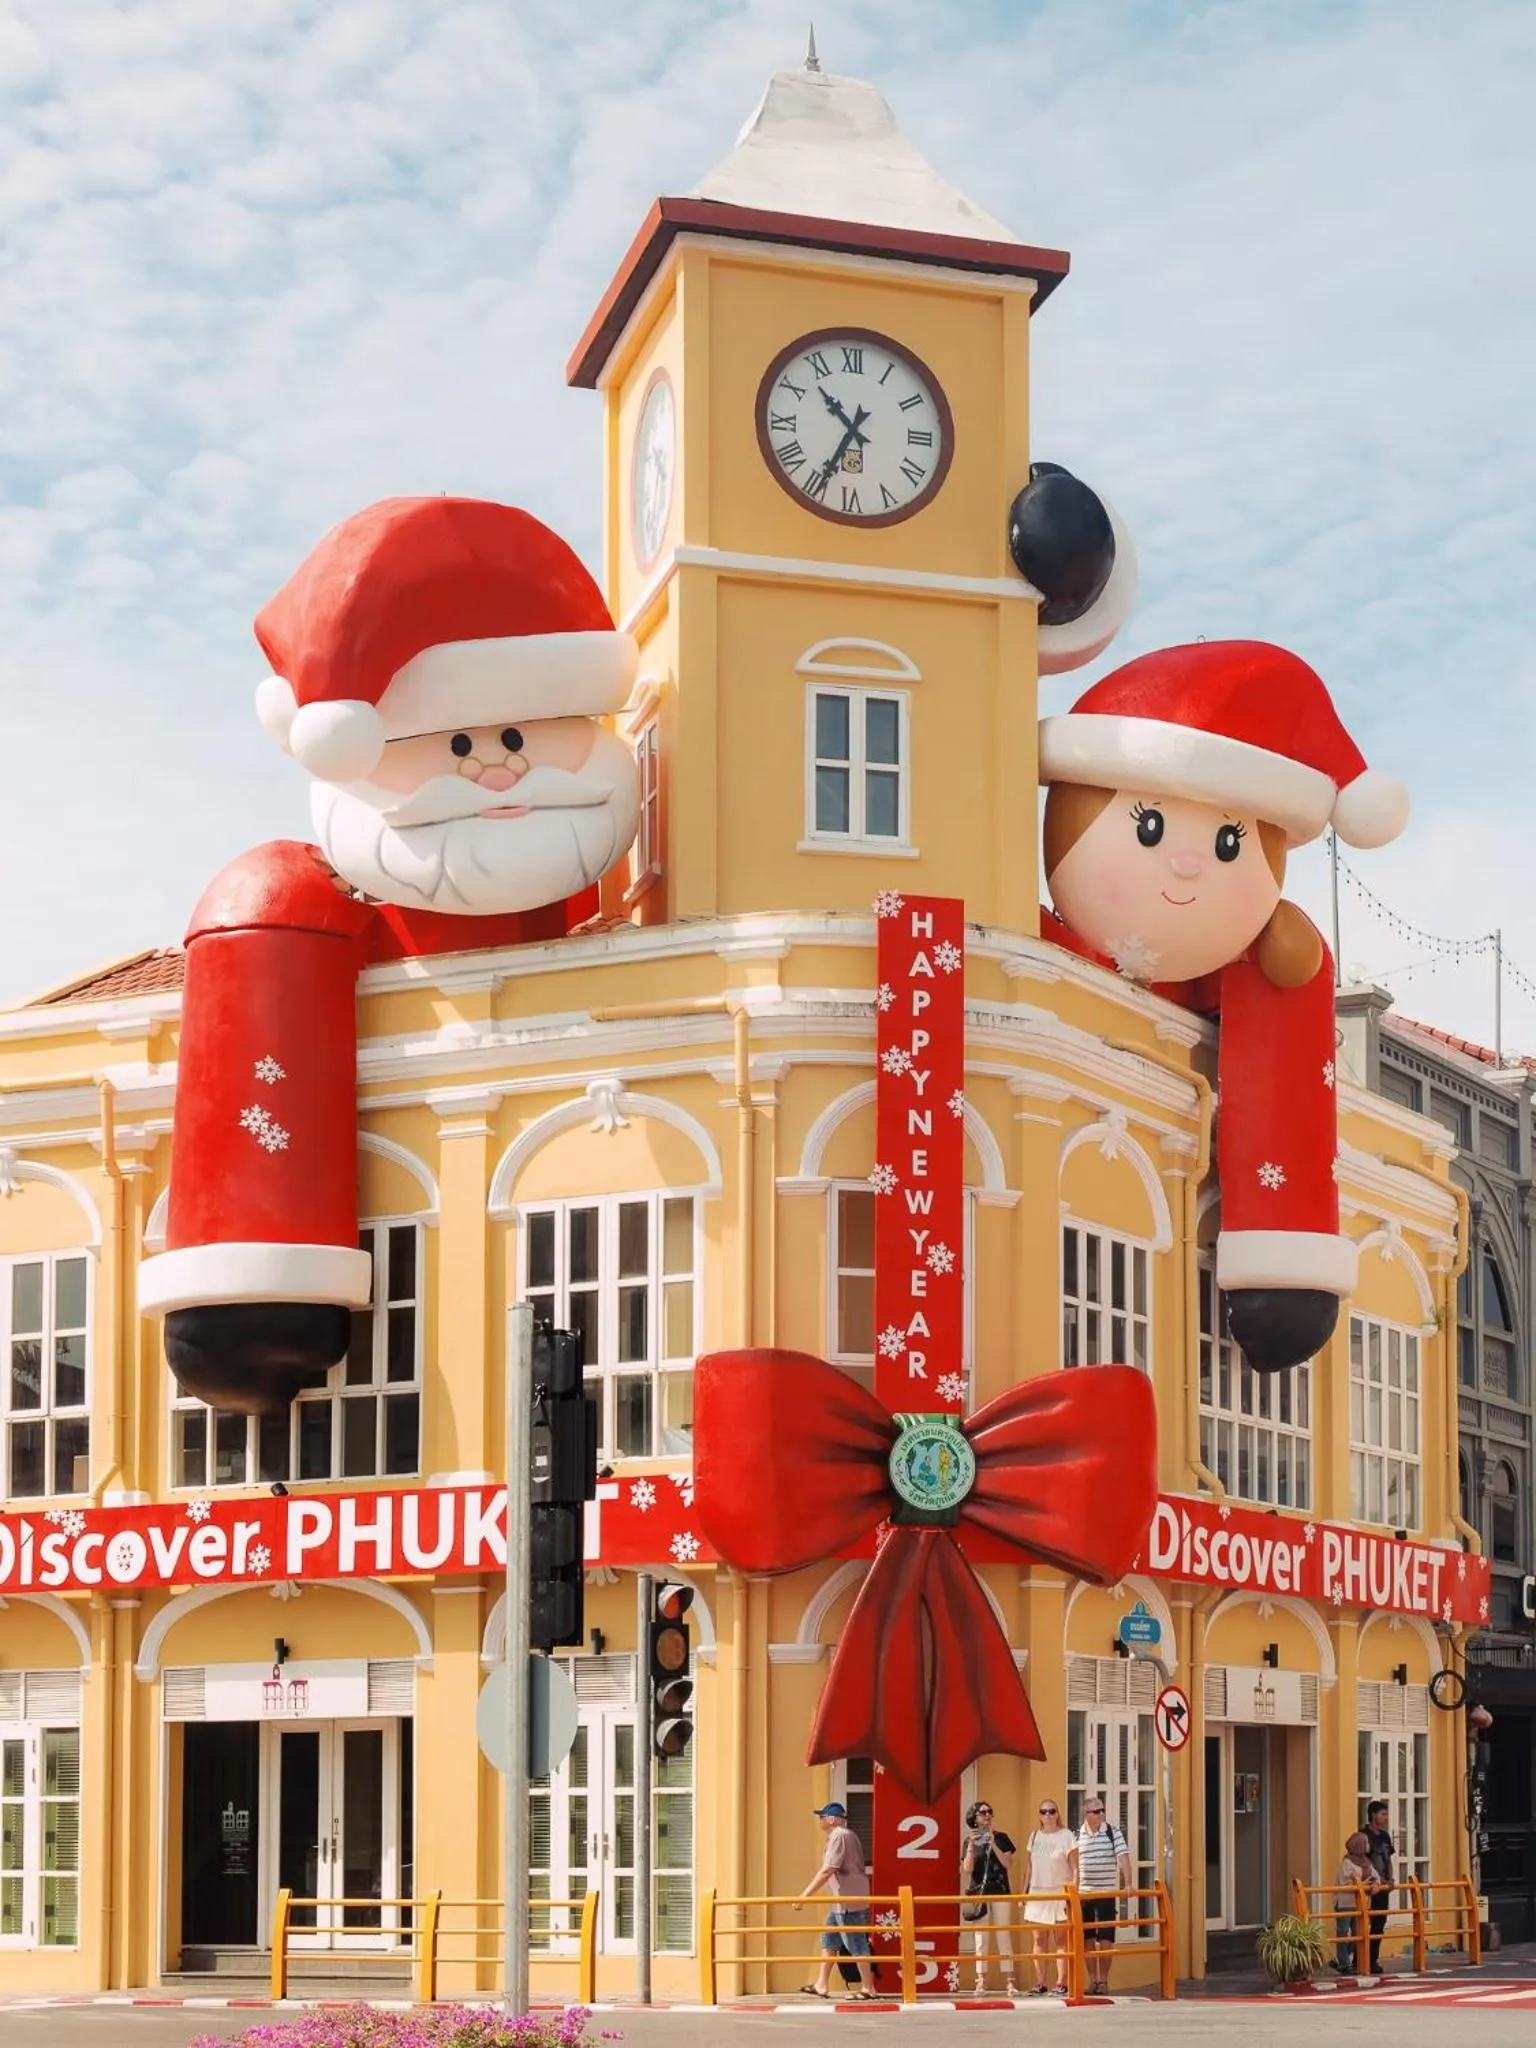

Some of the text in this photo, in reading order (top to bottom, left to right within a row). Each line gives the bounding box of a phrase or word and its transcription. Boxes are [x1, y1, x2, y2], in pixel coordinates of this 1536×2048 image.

[804, 351, 832, 380] XI
[841, 347, 864, 374] XII
[879, 362, 895, 385] I
[778, 375, 808, 402] X
[898, 393, 924, 412] II
[771, 410, 797, 433] IX
[907, 428, 932, 448] III
[776, 440, 807, 475] VIII
[899, 457, 926, 488] IV
[841, 486, 863, 513] VI
[880, 483, 899, 509] V
[908, 911, 936, 1096] HAPPY
[286, 1483, 619, 1574] PHUKT
[1149, 1501, 1446, 1614] Discover PHUKET
